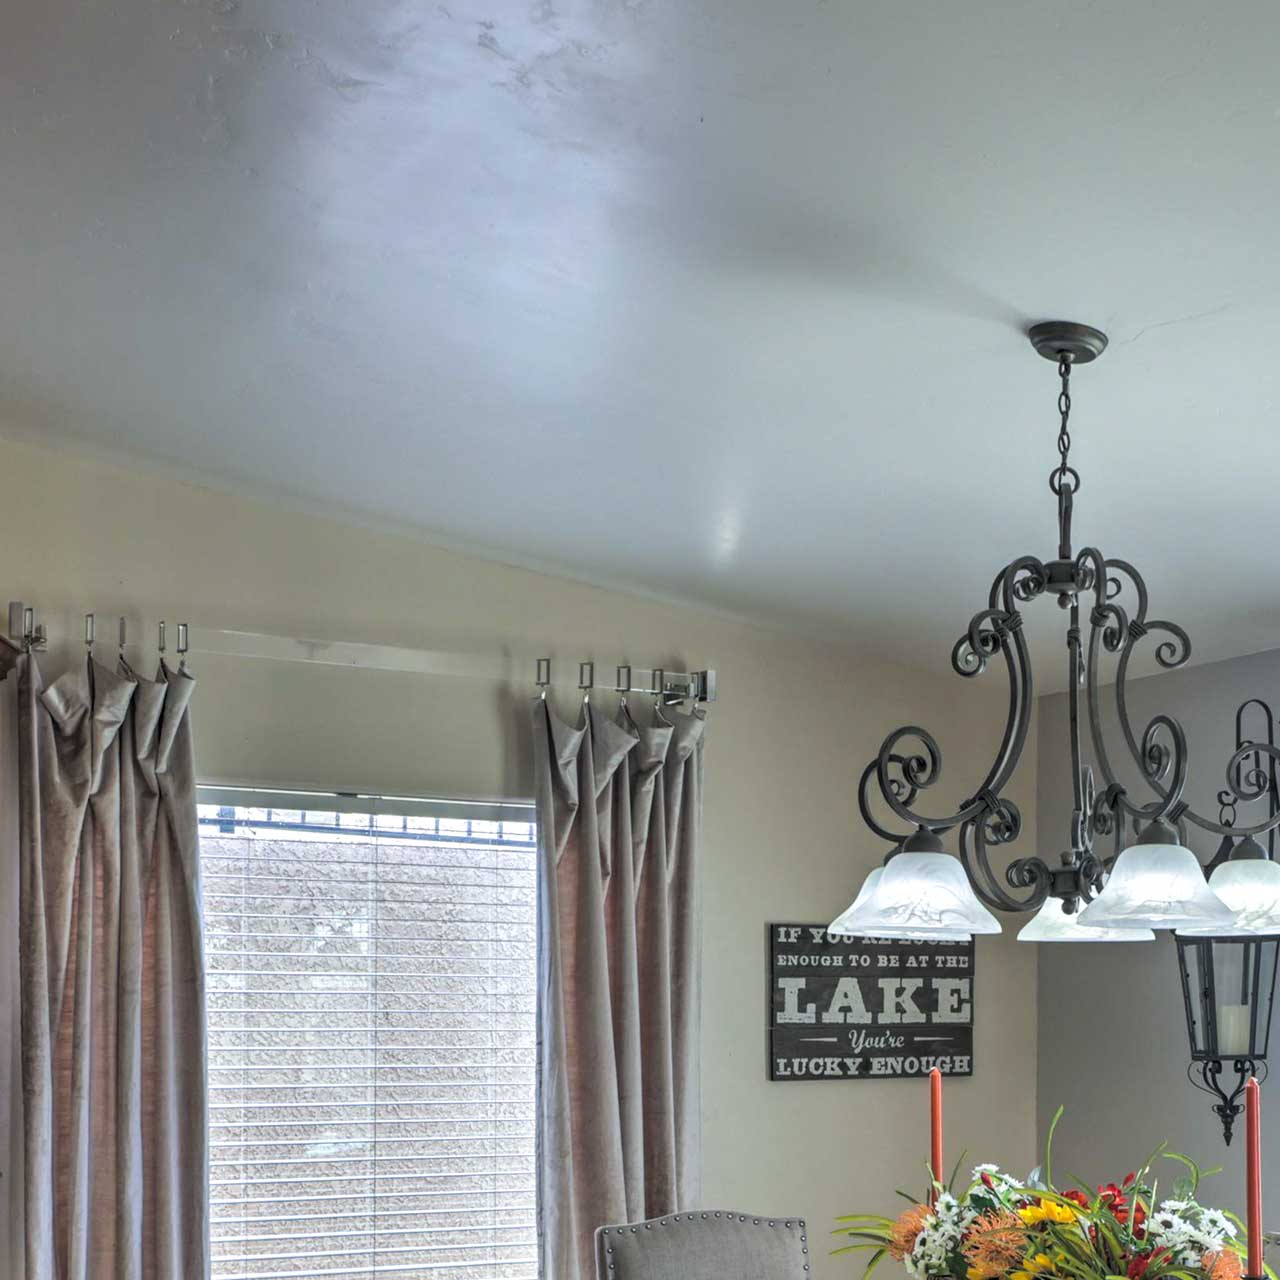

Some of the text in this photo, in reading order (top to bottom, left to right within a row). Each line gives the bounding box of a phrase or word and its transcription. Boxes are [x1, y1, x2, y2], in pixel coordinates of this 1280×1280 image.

[778, 927, 802, 943] IF
[777, 955, 969, 968] ENOUGH TO BE AT THE
[776, 977, 971, 1024] LAKE
[848, 1029, 904, 1054] You're
[776, 1056, 970, 1076] LUCKY ENOUGH
